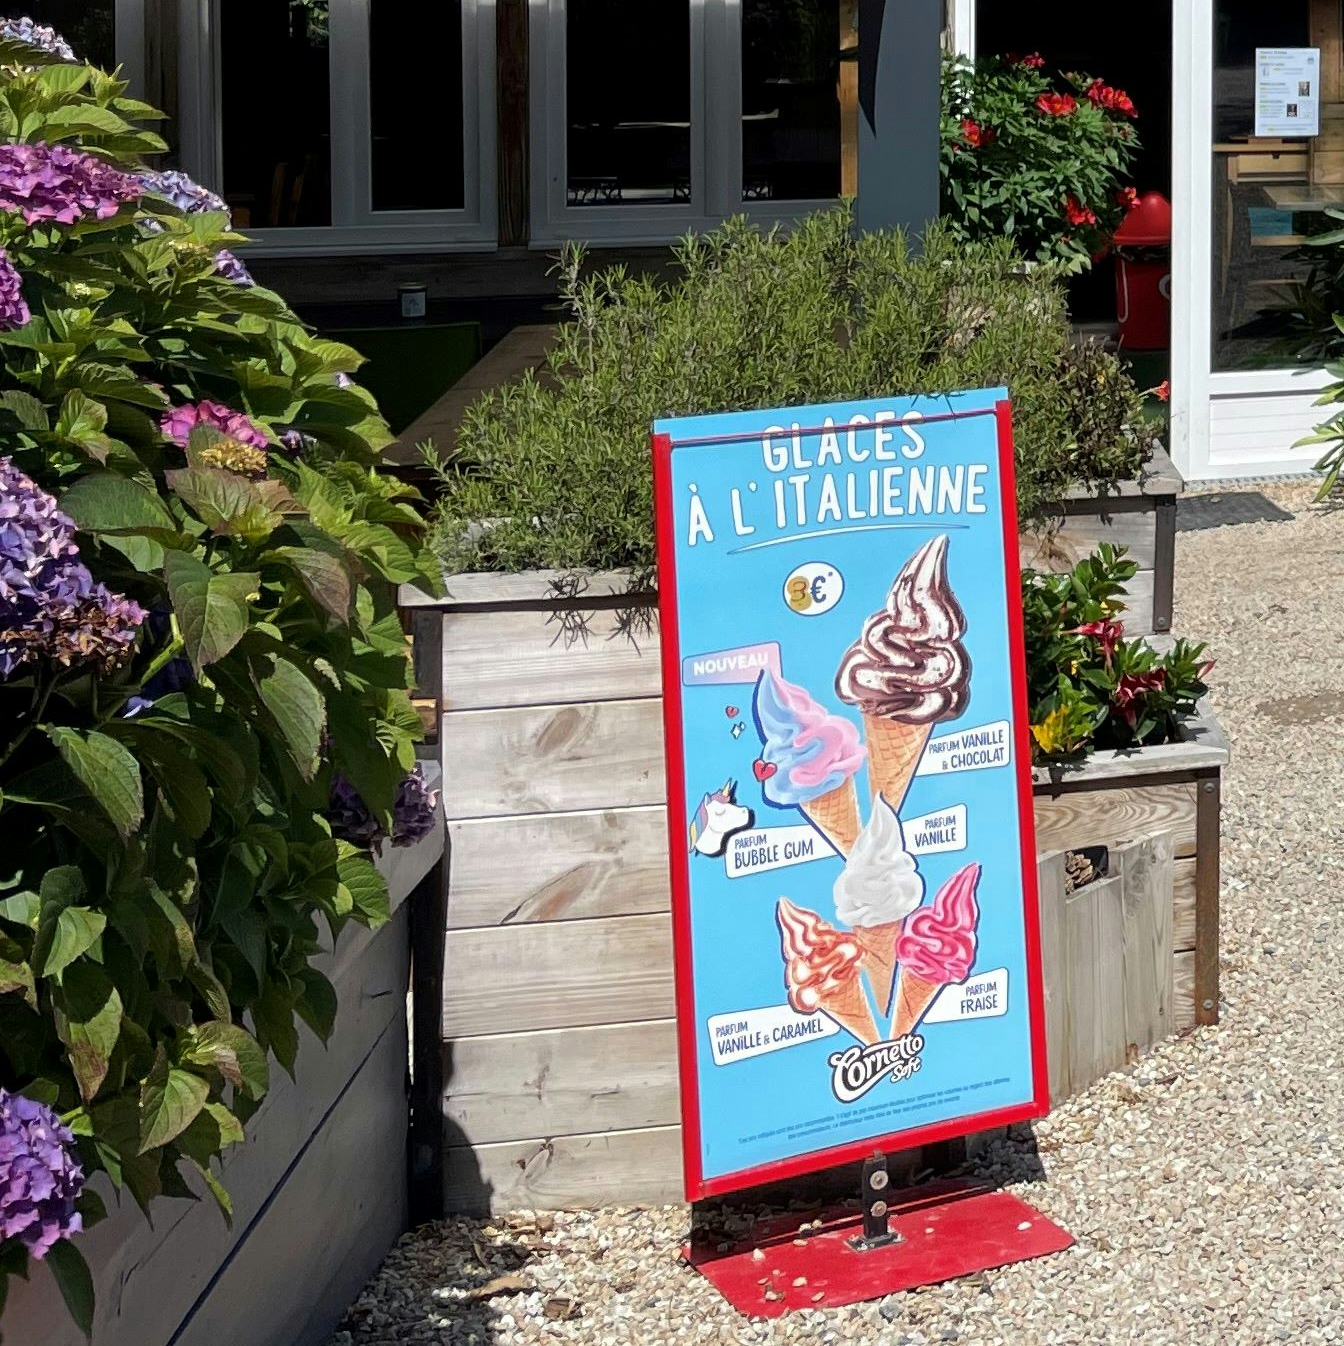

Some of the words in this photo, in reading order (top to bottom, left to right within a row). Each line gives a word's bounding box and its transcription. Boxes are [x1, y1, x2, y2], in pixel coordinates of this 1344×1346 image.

[762, 410, 925, 472] GLACES
[687, 483, 714, 546] À
[731, 464, 988, 536] L'ITALIENNE
[693, 652, 769, 676] NOUVEAU
[928, 740, 960, 754] PARFUM
[961, 729, 1004, 749] VANILLE
[950, 747, 1005, 769] CHOCOLAT
[924, 814, 957, 830] PARFUM
[734, 833, 767, 850] PARFUM
[914, 827, 957, 847] VANILLE
[734, 844, 779, 870] BUBBLE
[784, 837, 814, 860] GUM
[965, 981, 998, 997] PARFUM
[960, 993, 998, 1015] FRAISE
[715, 1021, 749, 1038] PARFUM
[772, 1018, 824, 1043] CARAMEL
[831, 1035, 924, 1102] Cornetto
[890, 1057, 922, 1083] Soft
